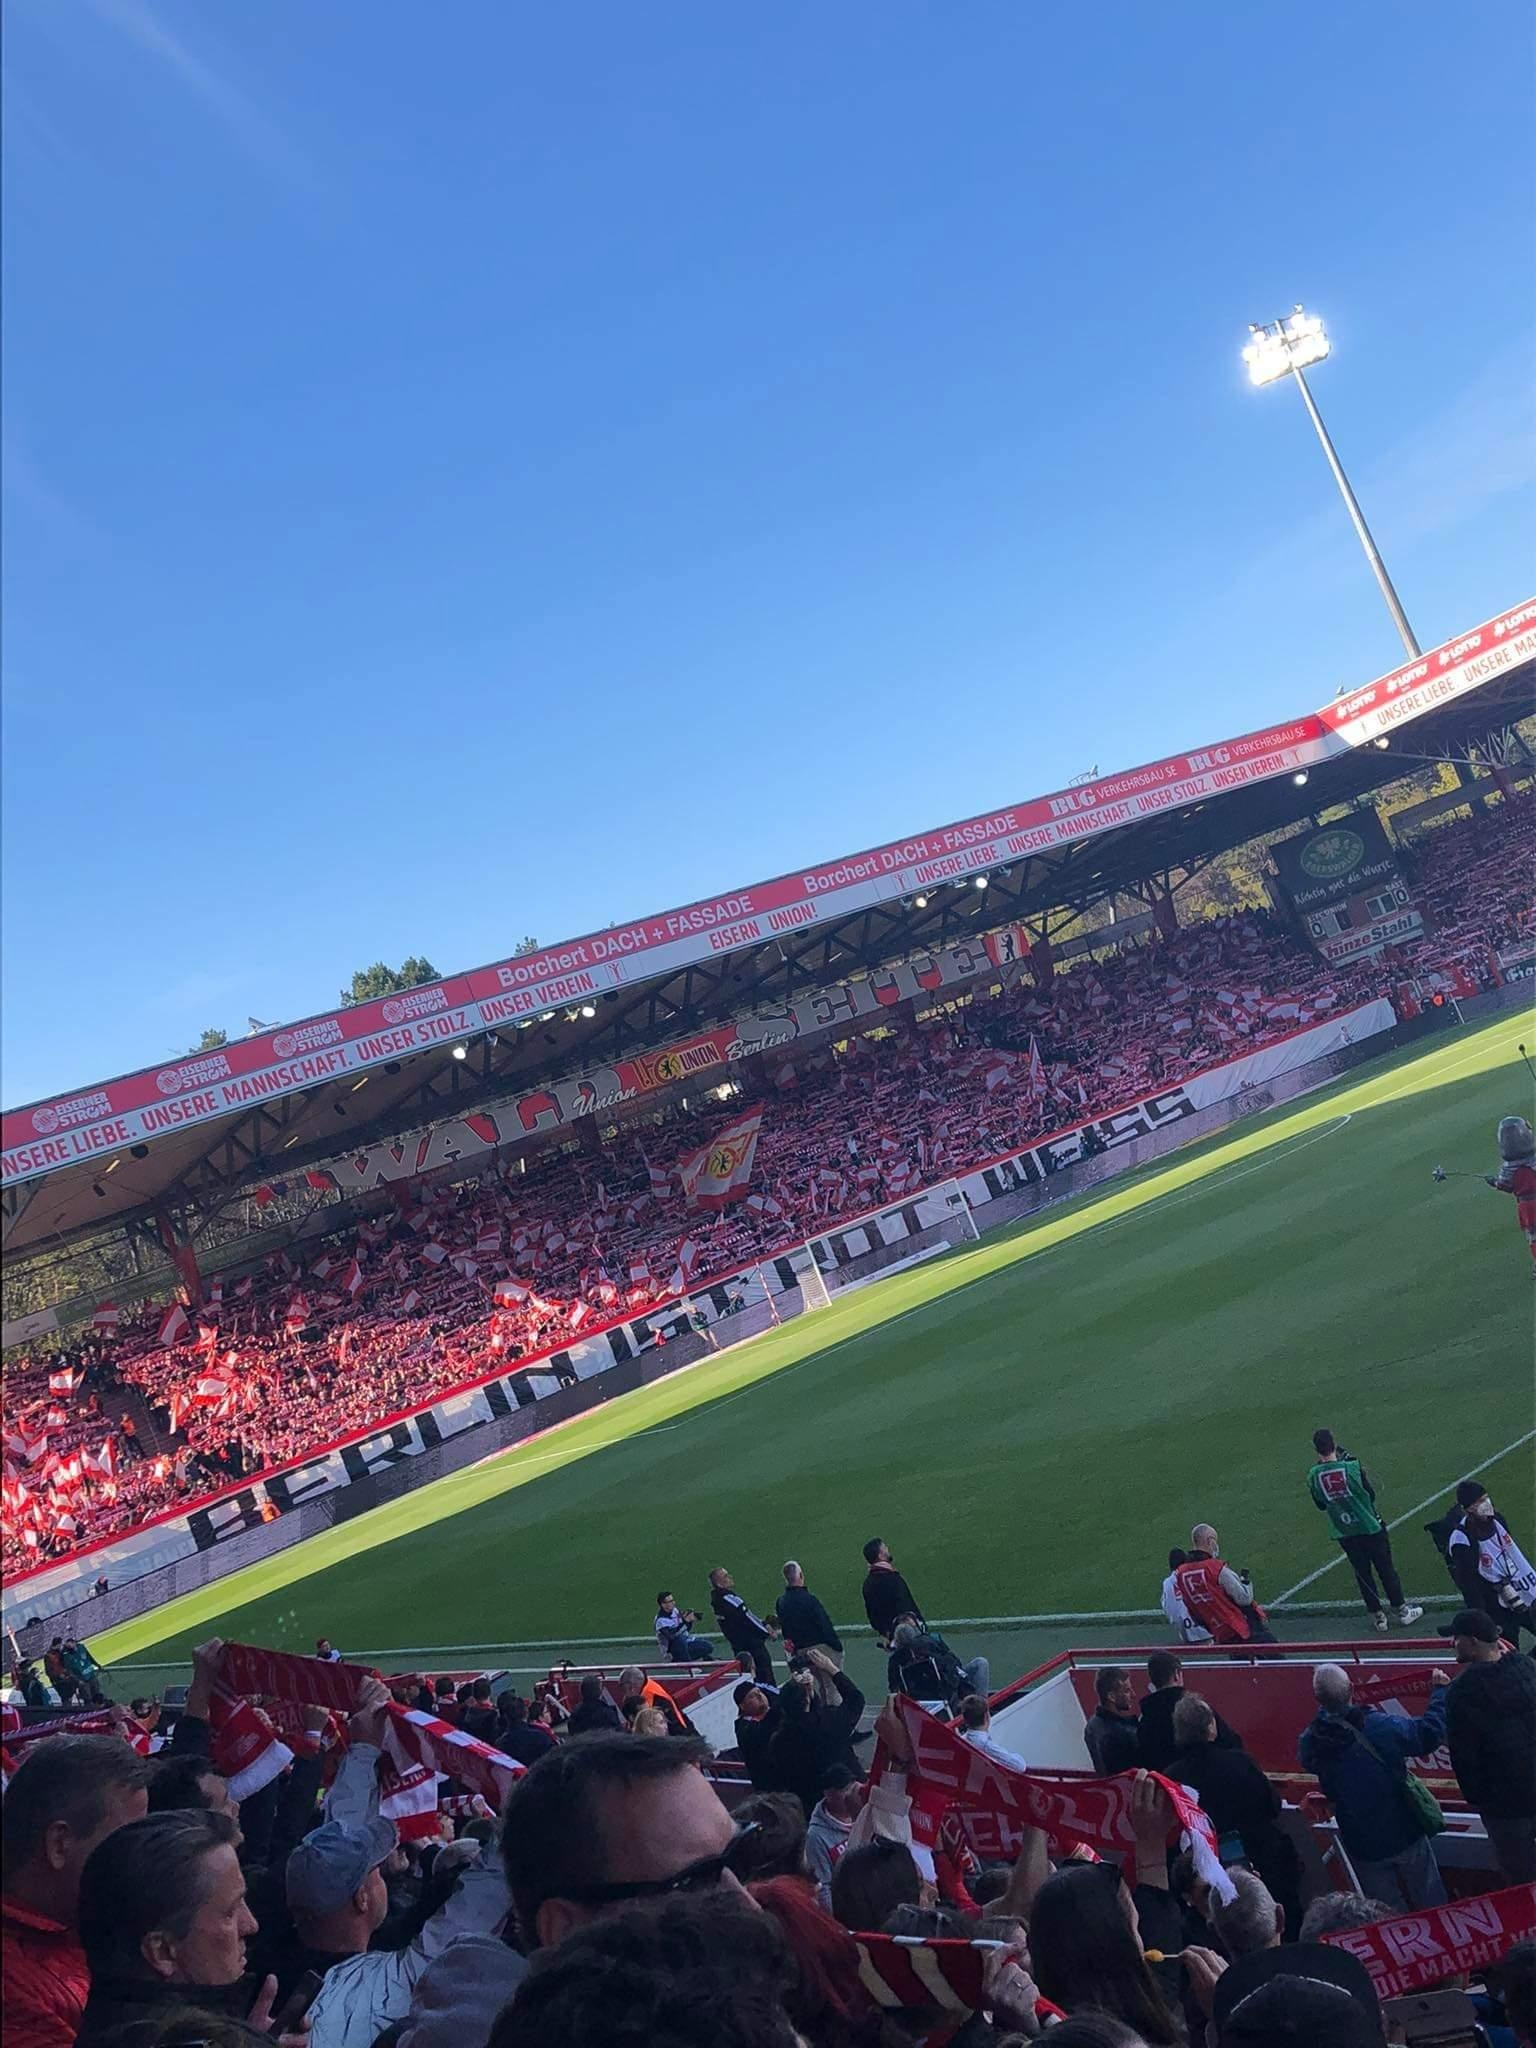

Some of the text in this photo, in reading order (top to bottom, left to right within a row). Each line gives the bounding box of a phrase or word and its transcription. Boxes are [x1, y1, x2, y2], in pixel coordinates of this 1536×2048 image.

[1377, 696, 1421, 725] UNSERE
[1464, 650, 1512, 682] UNSERE
[1514, 633, 1536, 656] MA
[1232, 731, 1293, 757] VERKEHRSBAU
[1294, 727, 1306, 738] SE
[1049, 765, 1177, 817] BUG VERKEHRSBAU SE
[804, 814, 1018, 893] Borchert DACH + FASSADE
[2, 755, 1288, 1176] NSERE LIEBE. UNSERE MANNSCHAFT. UNSER STOLZ. UNSER VEREIN. EISERN UNION! UNSERE LIEBE. UNSERE MANNSCHAFT. UNSER STOLZ. UNSER VEREIN.
[497, 895, 754, 988] Borchert DACH + FASSADE
[401, 987, 443, 1009] EISERNER
[293, 1020, 339, 1041] EISERNER
[681, 1045, 718, 1071] UNION
[178, 1055, 227, 1077] EISERNER
[572, 1031, 793, 1117] Union Berlin
[55, 1092, 108, 1113] EISERNER
[187, 1351, 583, 1552] BERLIN
[1372, 1938, 1504, 1999] DIE MACHT
